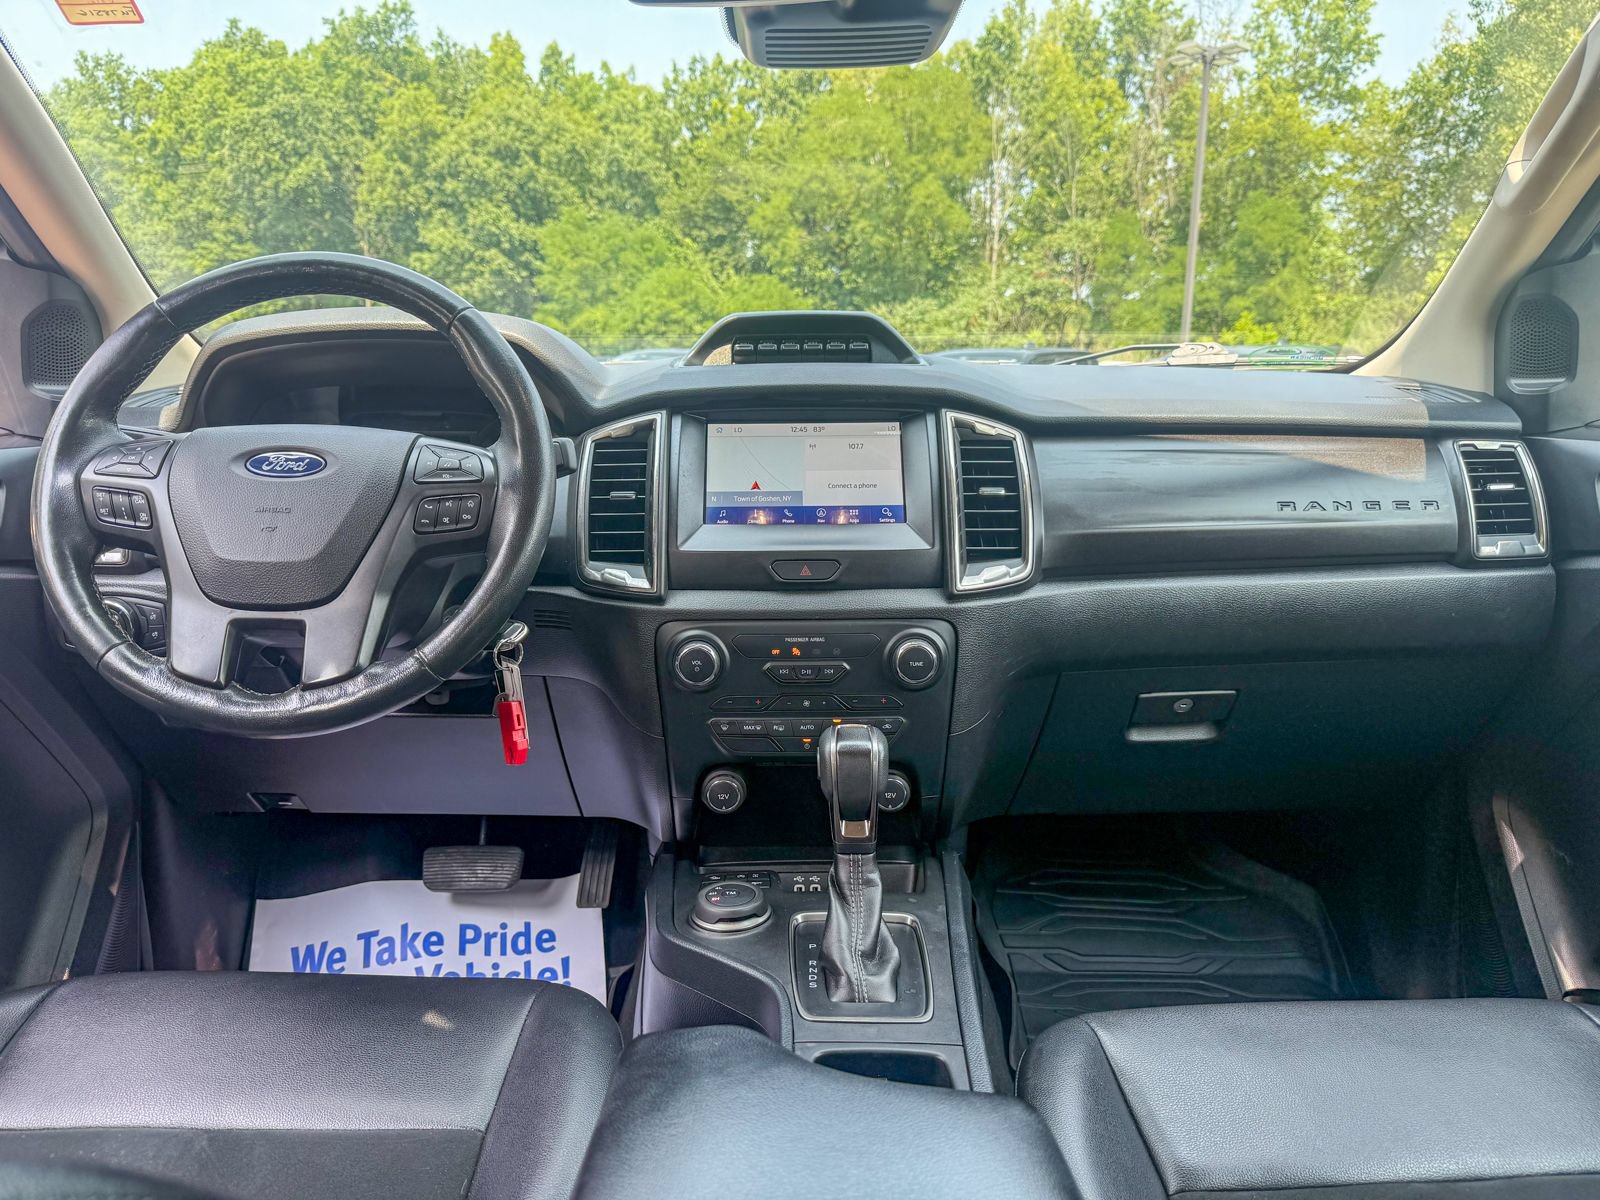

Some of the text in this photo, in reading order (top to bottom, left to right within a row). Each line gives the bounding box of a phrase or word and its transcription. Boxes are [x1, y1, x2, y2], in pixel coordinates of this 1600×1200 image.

[261, 454, 308, 472] Ford
[859, 482, 878, 491] phone
[758, 495, 782, 503] Goshen,
[1276, 500, 1440, 511] RANGER
[290, 921, 557, 974] We Take Pride
